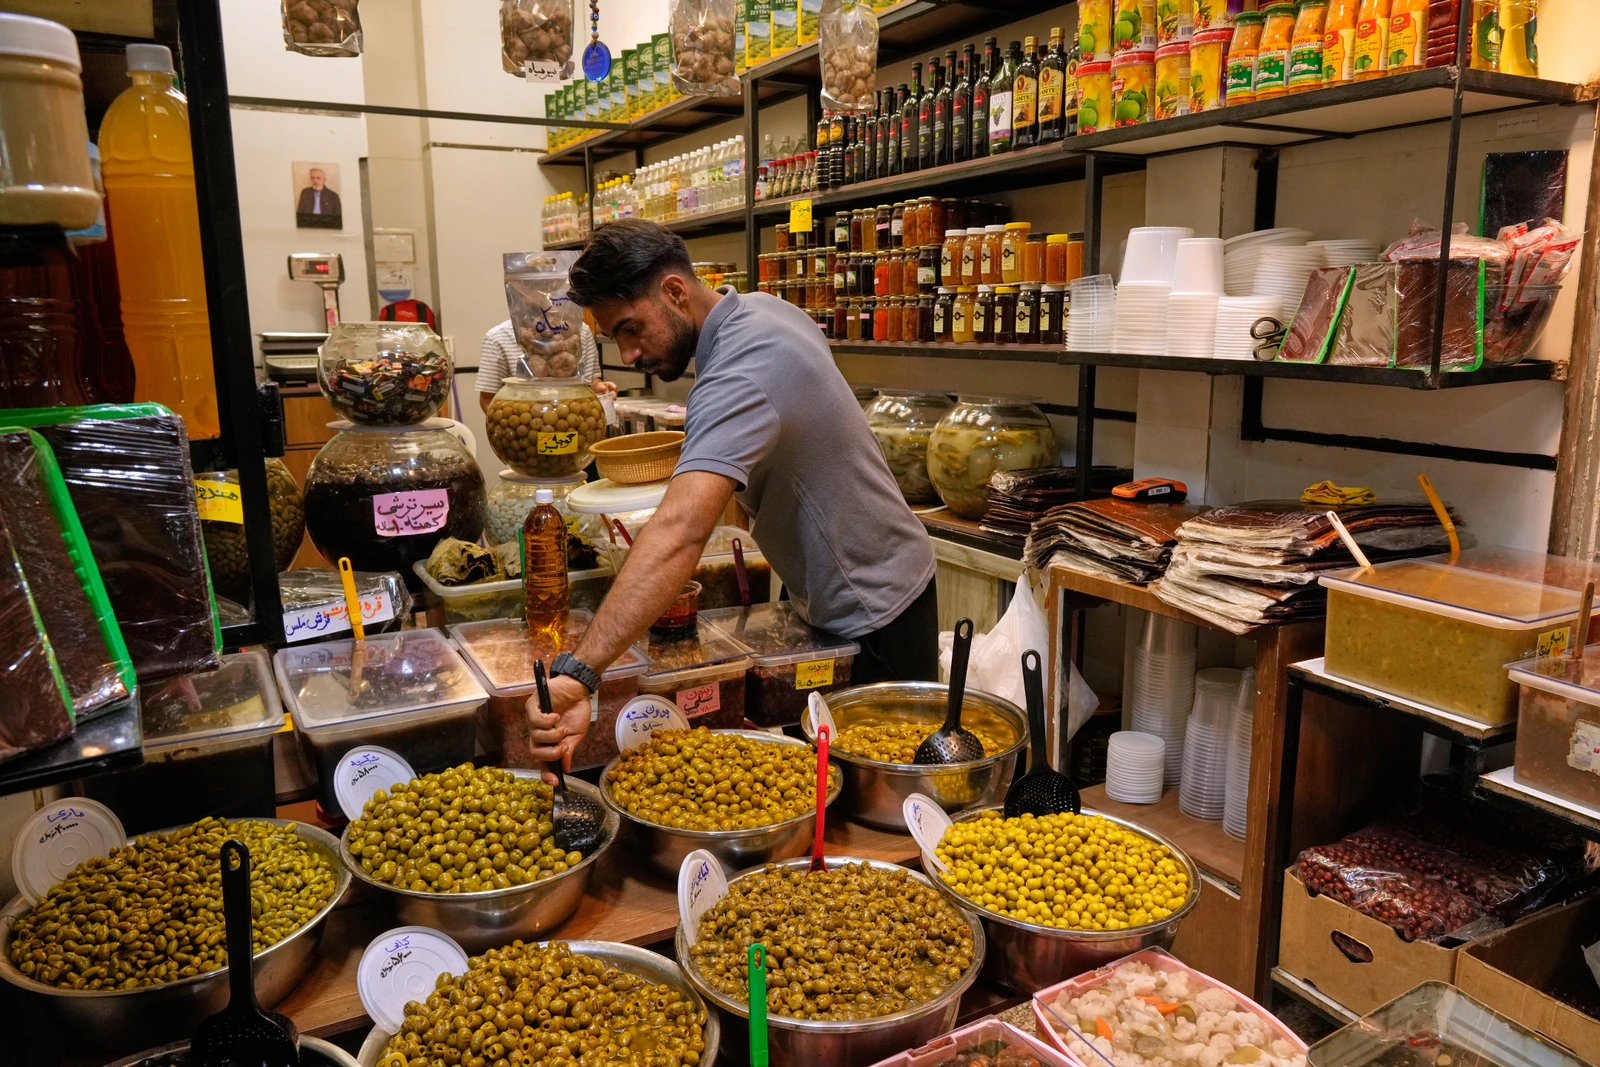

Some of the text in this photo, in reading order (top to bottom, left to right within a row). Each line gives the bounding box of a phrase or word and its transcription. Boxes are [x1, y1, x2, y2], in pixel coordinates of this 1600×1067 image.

[377, 496, 445, 520] سیر ترشی
[685, 685, 714, 700] زیتون
[384, 935, 410, 953] کبابی
